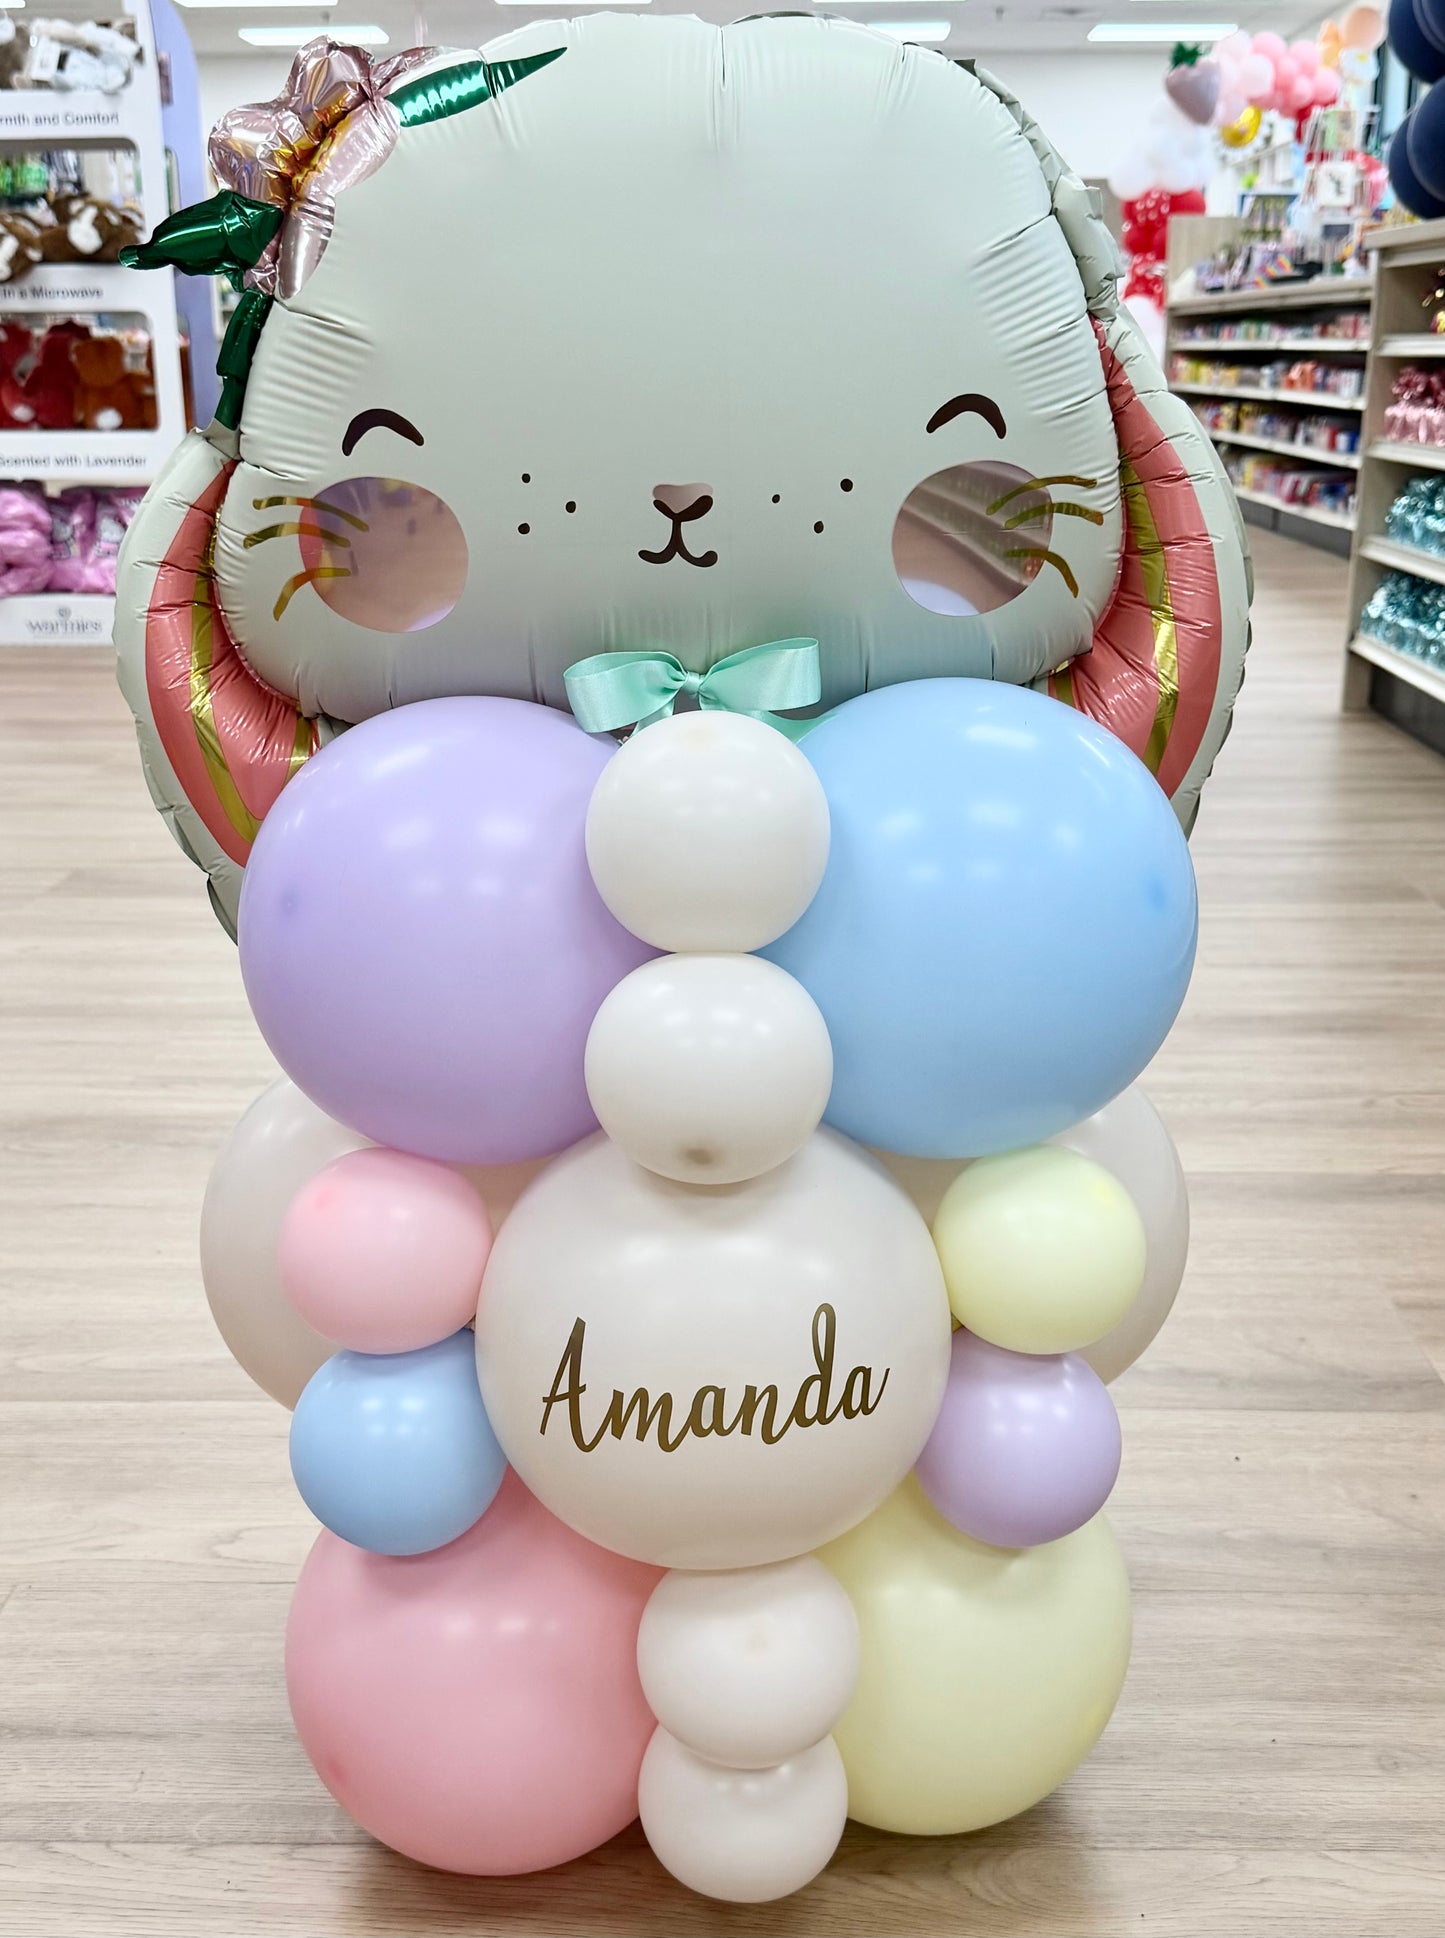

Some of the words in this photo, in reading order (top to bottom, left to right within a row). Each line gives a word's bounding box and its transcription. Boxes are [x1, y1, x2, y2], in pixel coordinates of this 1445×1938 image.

[33, 112, 60, 126] and
[63, 111, 119, 125] Comfort
[19, 288, 28, 299] a
[31, 286, 103, 299] Microwave
[0, 455, 50, 468] Scented
[54, 455, 82, 468] with
[86, 454, 146, 468] Lavender
[539, 1302, 890, 1453] Amanda
